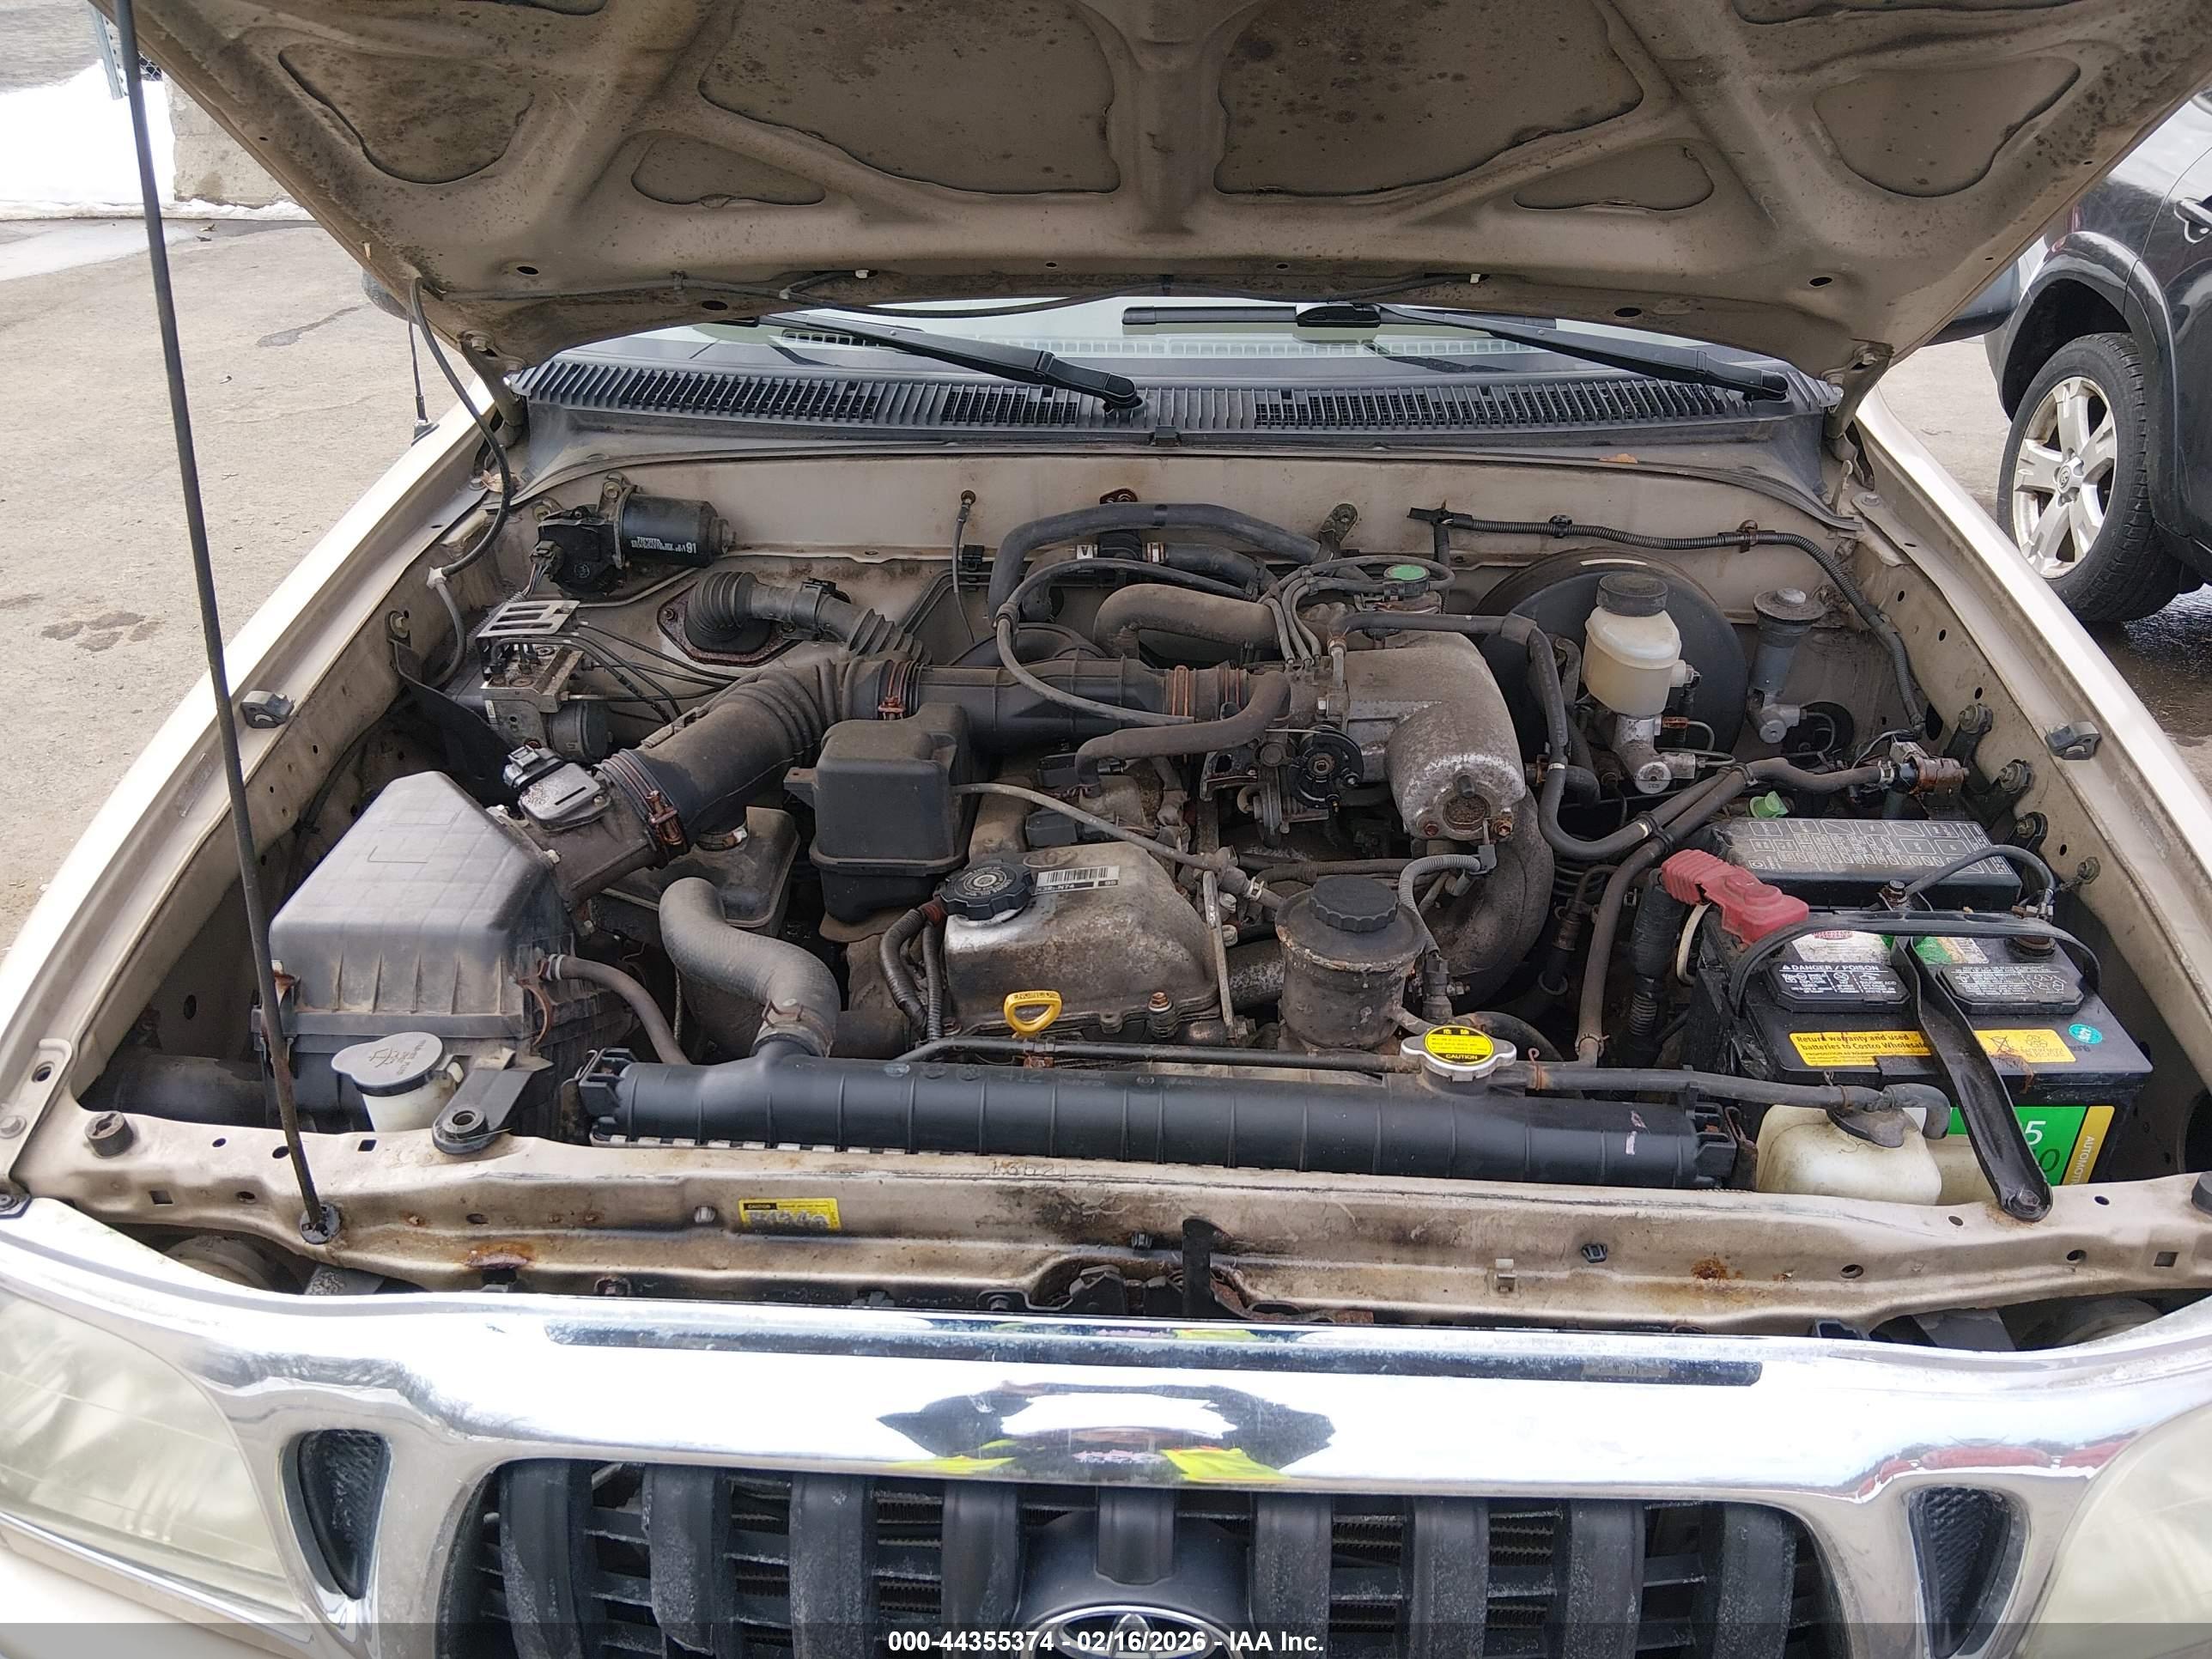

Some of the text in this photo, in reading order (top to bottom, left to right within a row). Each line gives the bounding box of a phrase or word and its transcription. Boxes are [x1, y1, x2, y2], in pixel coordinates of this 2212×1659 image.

[686, 542, 697, 554] 91
[1828, 1035, 1868, 1043] warranty
[2025, 1120, 2046, 1146] 5
